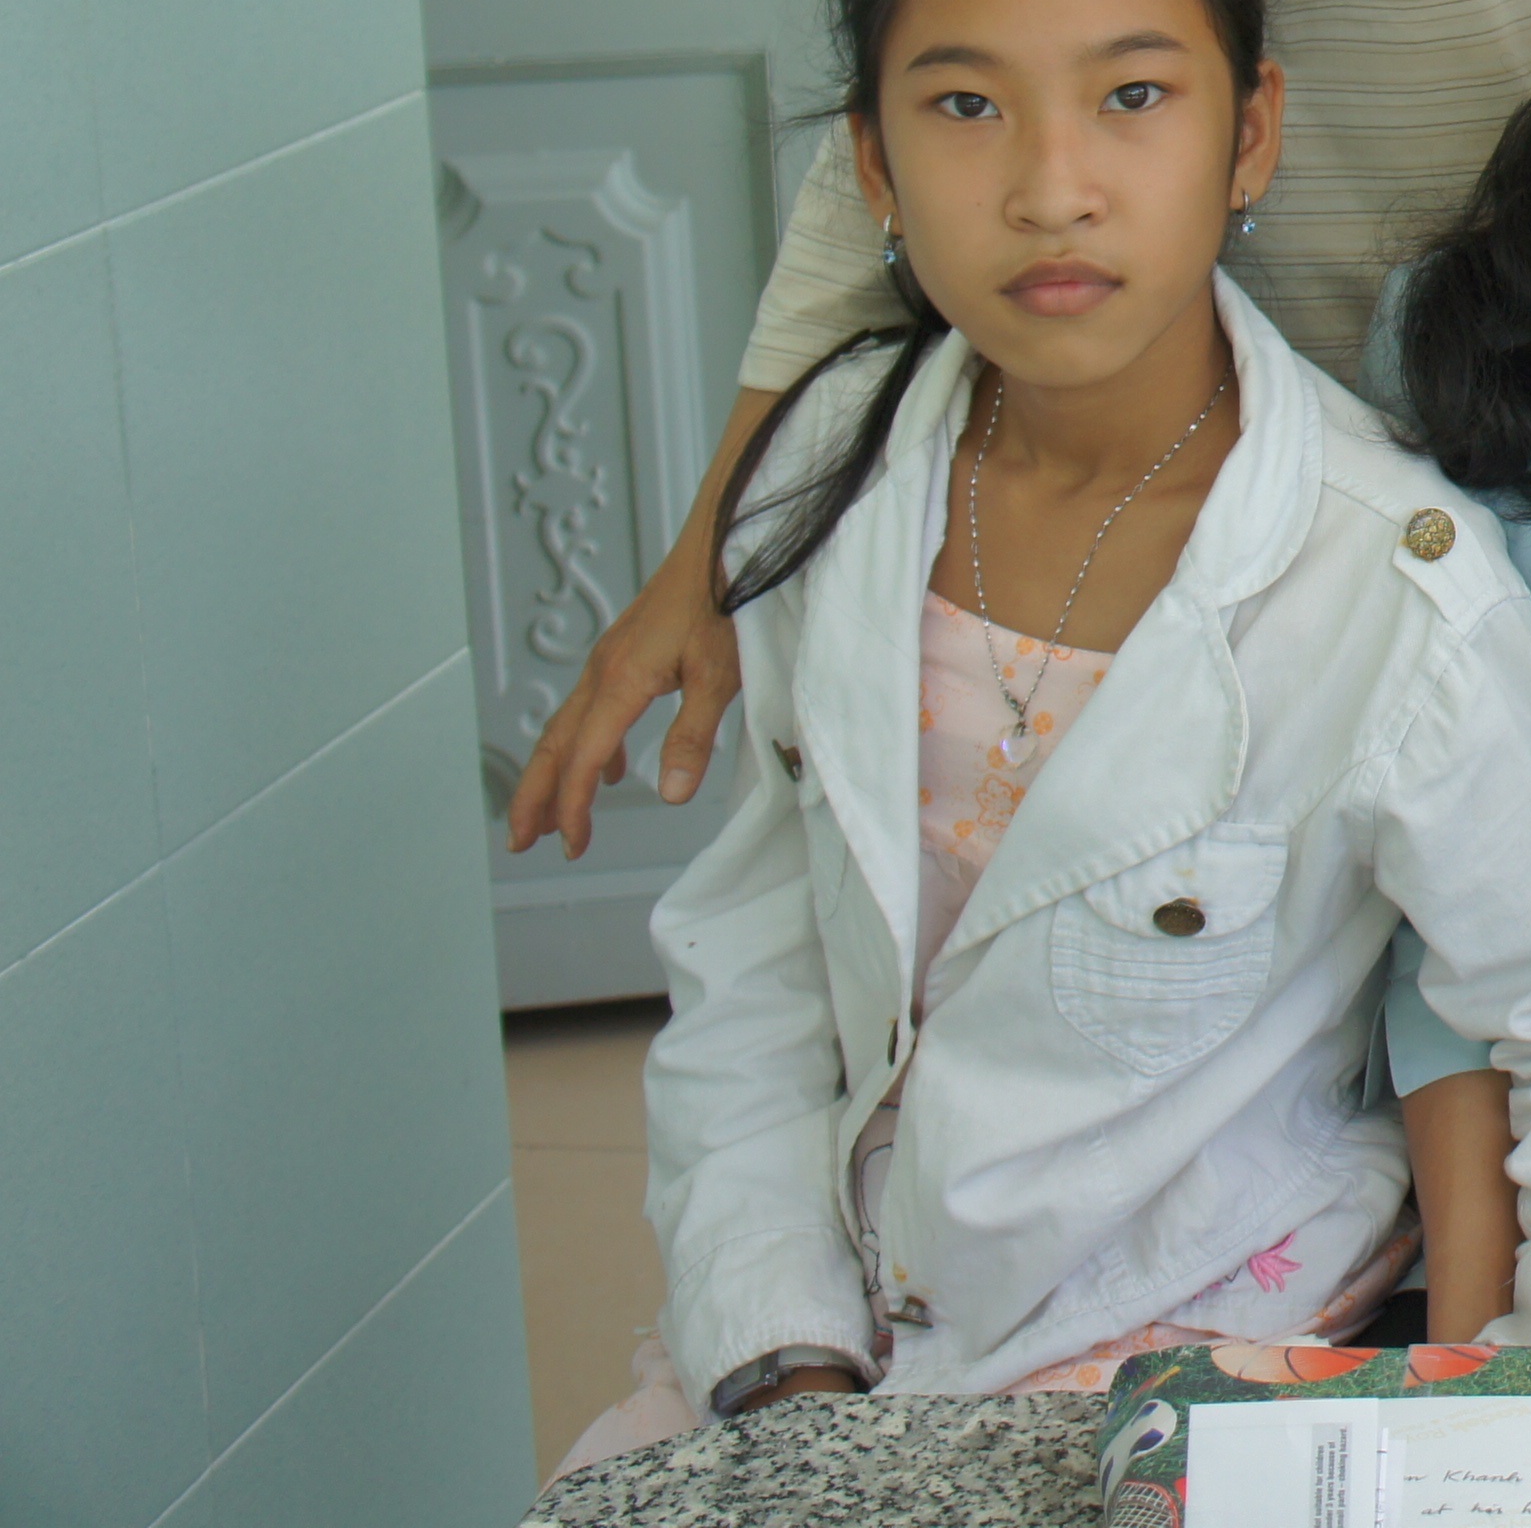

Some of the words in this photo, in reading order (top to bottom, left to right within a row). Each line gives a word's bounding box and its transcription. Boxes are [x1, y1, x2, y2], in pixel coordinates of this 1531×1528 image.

[1316, 1446, 1324, 1474] children
[1327, 1451, 1335, 1480] because
[1338, 1454, 1347, 1481] choking
[1421, 1503, 1453, 1515] at
